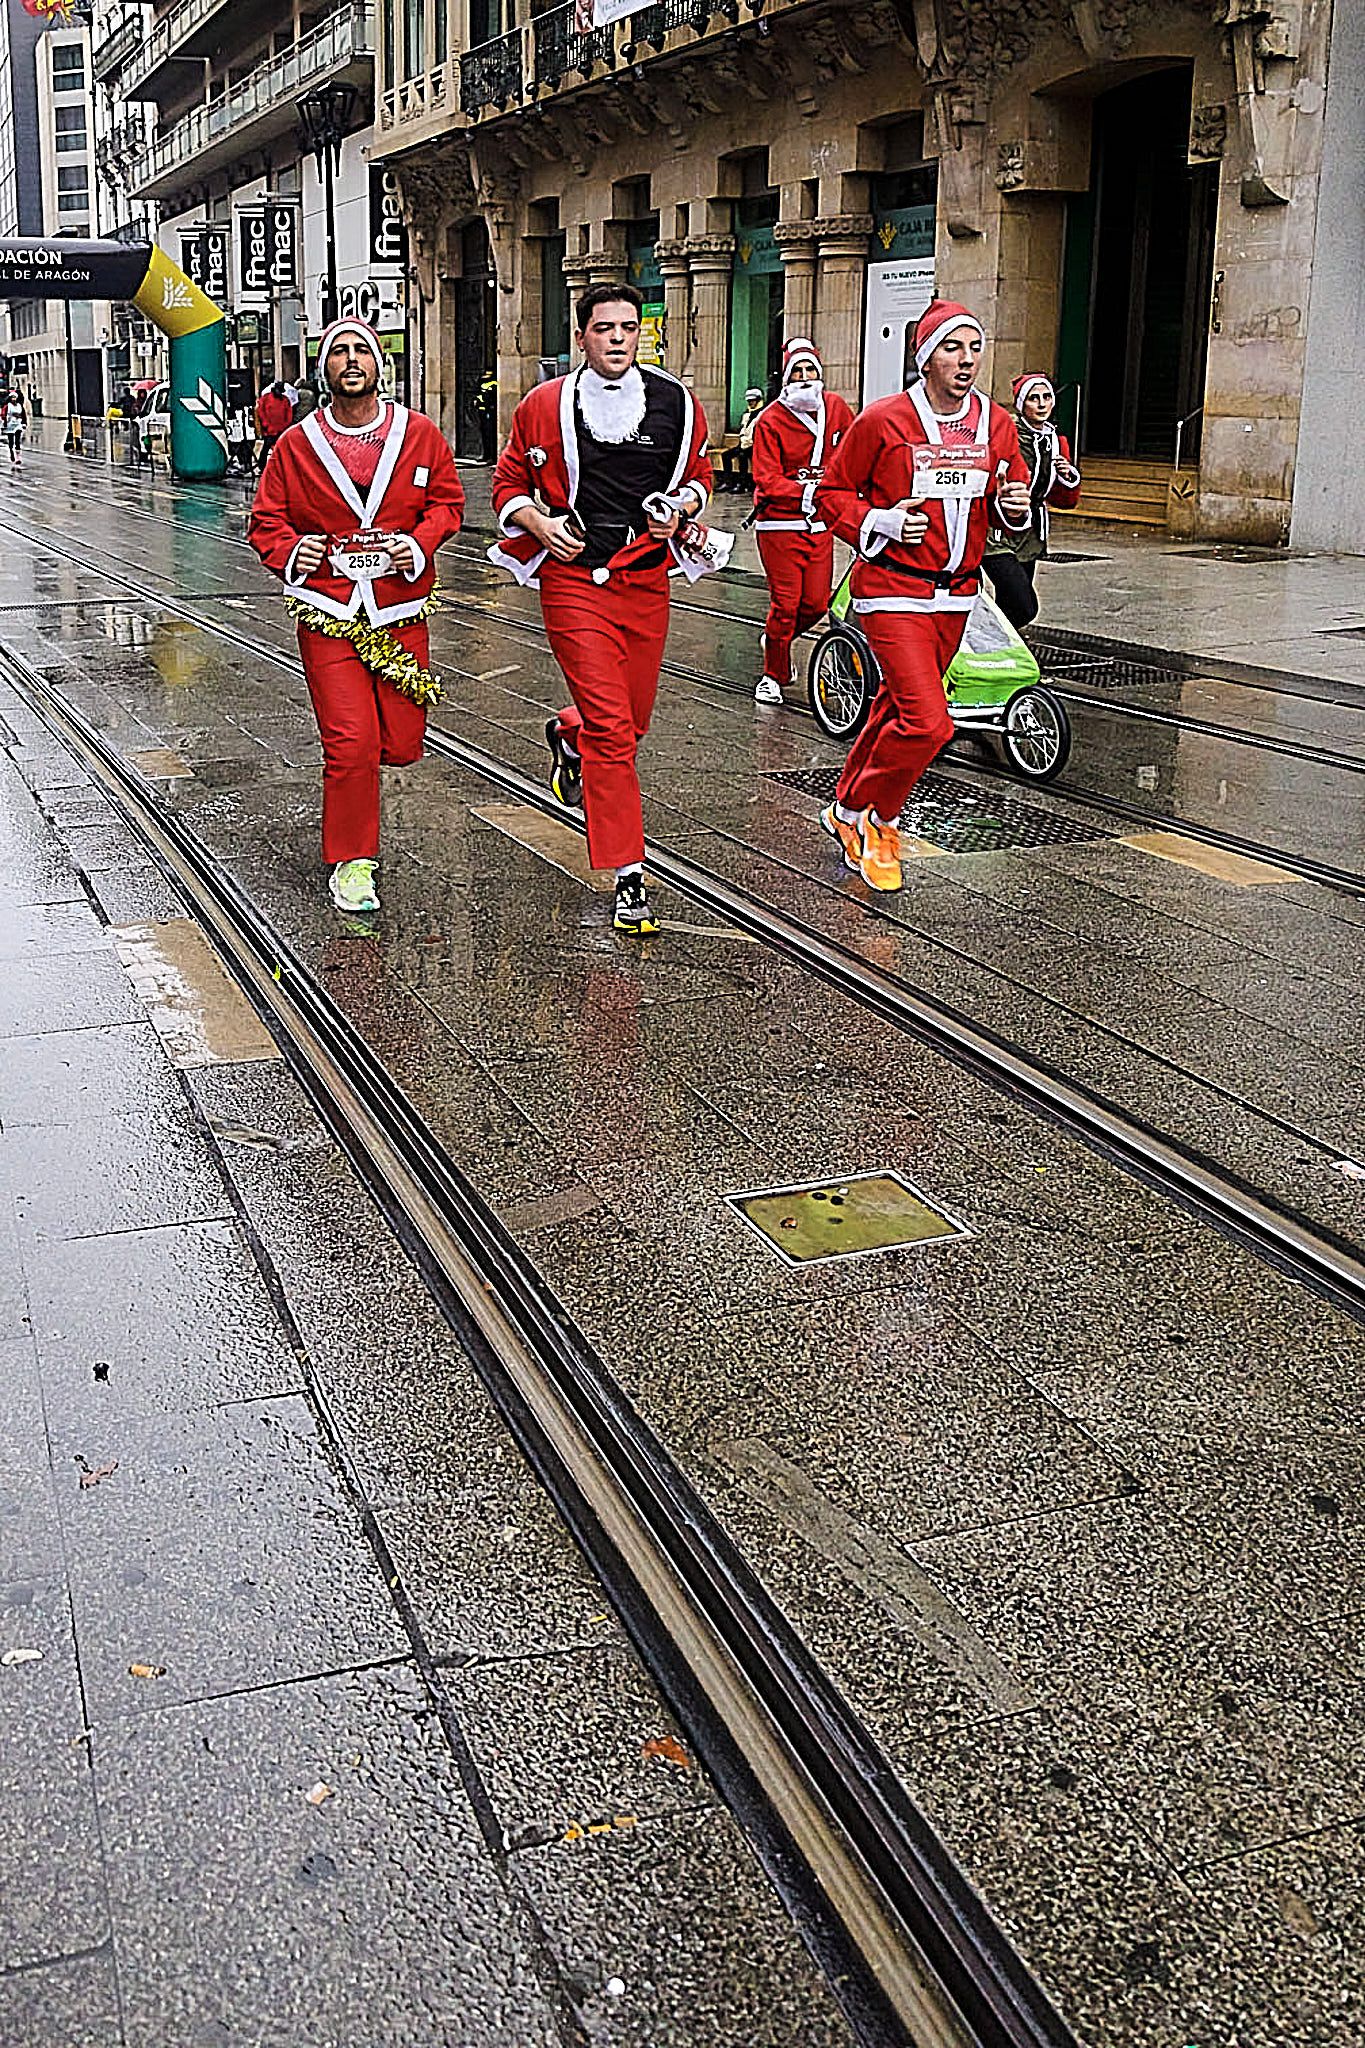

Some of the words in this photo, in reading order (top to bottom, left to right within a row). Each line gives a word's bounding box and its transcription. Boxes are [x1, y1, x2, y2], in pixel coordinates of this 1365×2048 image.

[375, 172, 401, 257] fnac
[14, 270, 31, 279] DE
[35, 268, 90, 280] ARAGÓN
[204, 236, 224, 297] fnac
[245, 220, 266, 287] fnac
[270, 210, 292, 282] fnac
[935, 471, 966, 484] 2561
[348, 554, 380, 568] 2552
